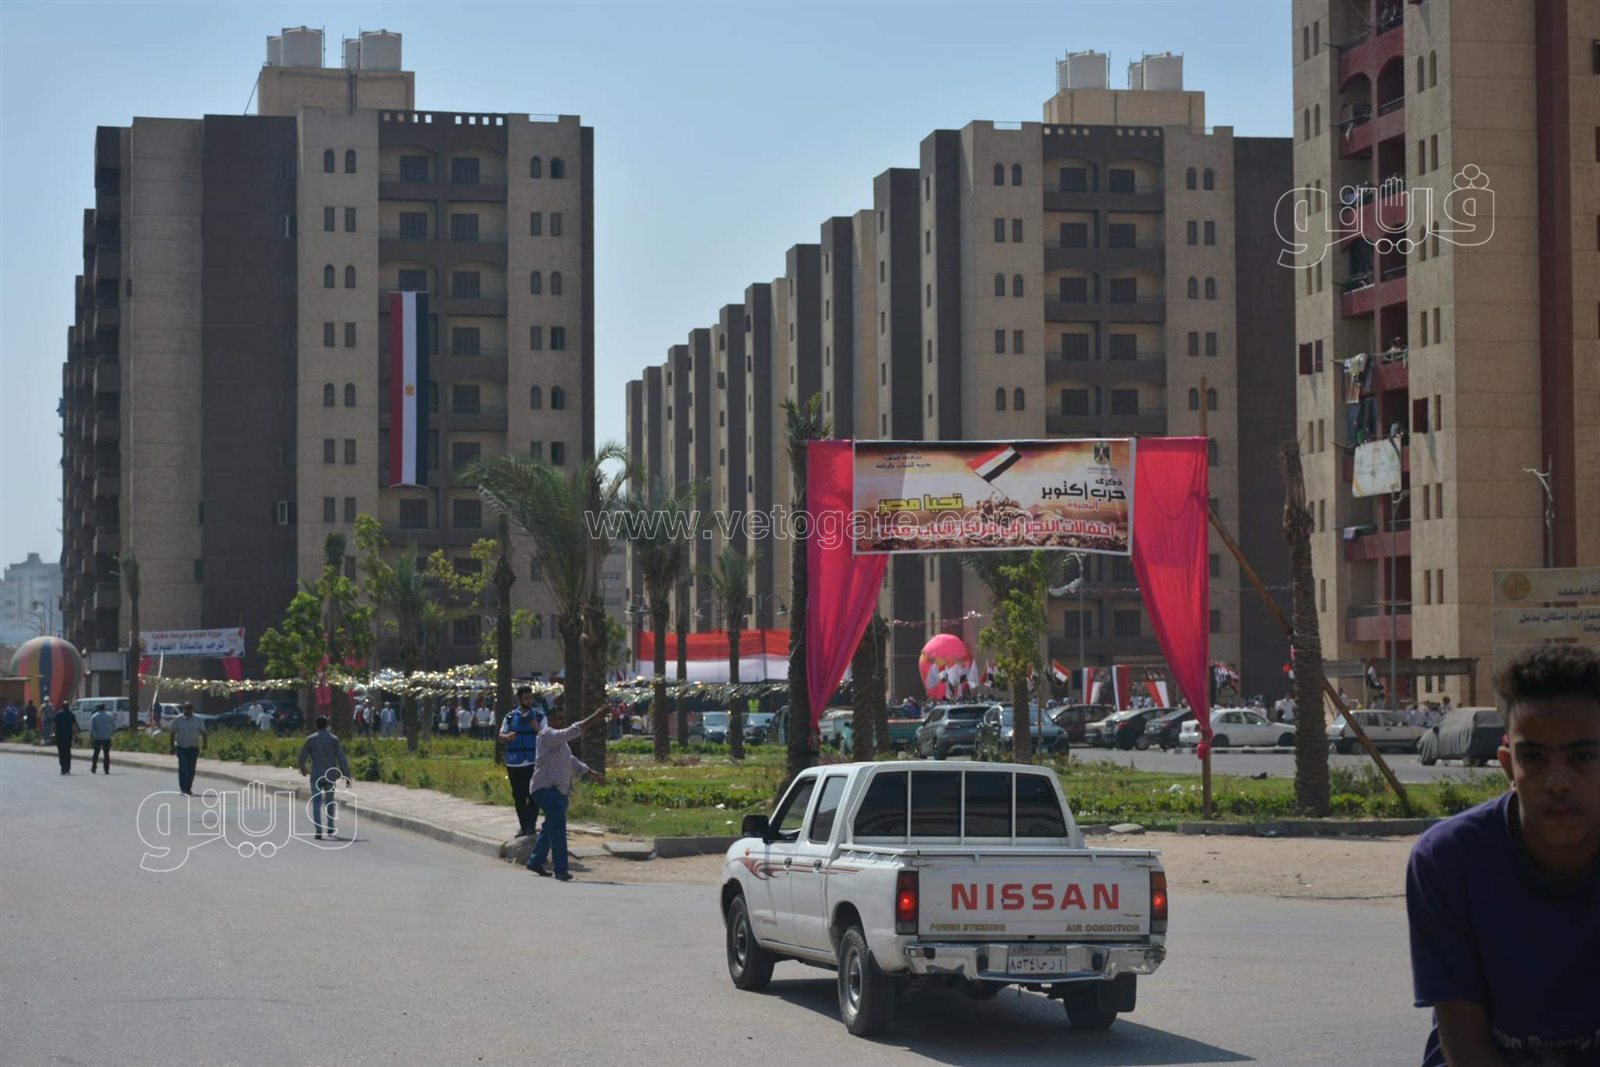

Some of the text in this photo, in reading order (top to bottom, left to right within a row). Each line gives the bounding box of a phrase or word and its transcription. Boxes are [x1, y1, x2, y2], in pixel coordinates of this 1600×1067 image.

[1091, 488, 1126, 502] حرب
[879, 493, 965, 516] تحيا مصر
[1025, 520, 1060, 534] النصر
[1063, 520, 1115, 537] احتفالات
[951, 883, 1119, 910] NISSAN
[930, 923, 1006, 932] POWER STEERING
[1066, 923, 1140, 933] AIR CONDITION
[1009, 958, 1036, 971] ٨٥٣٤
